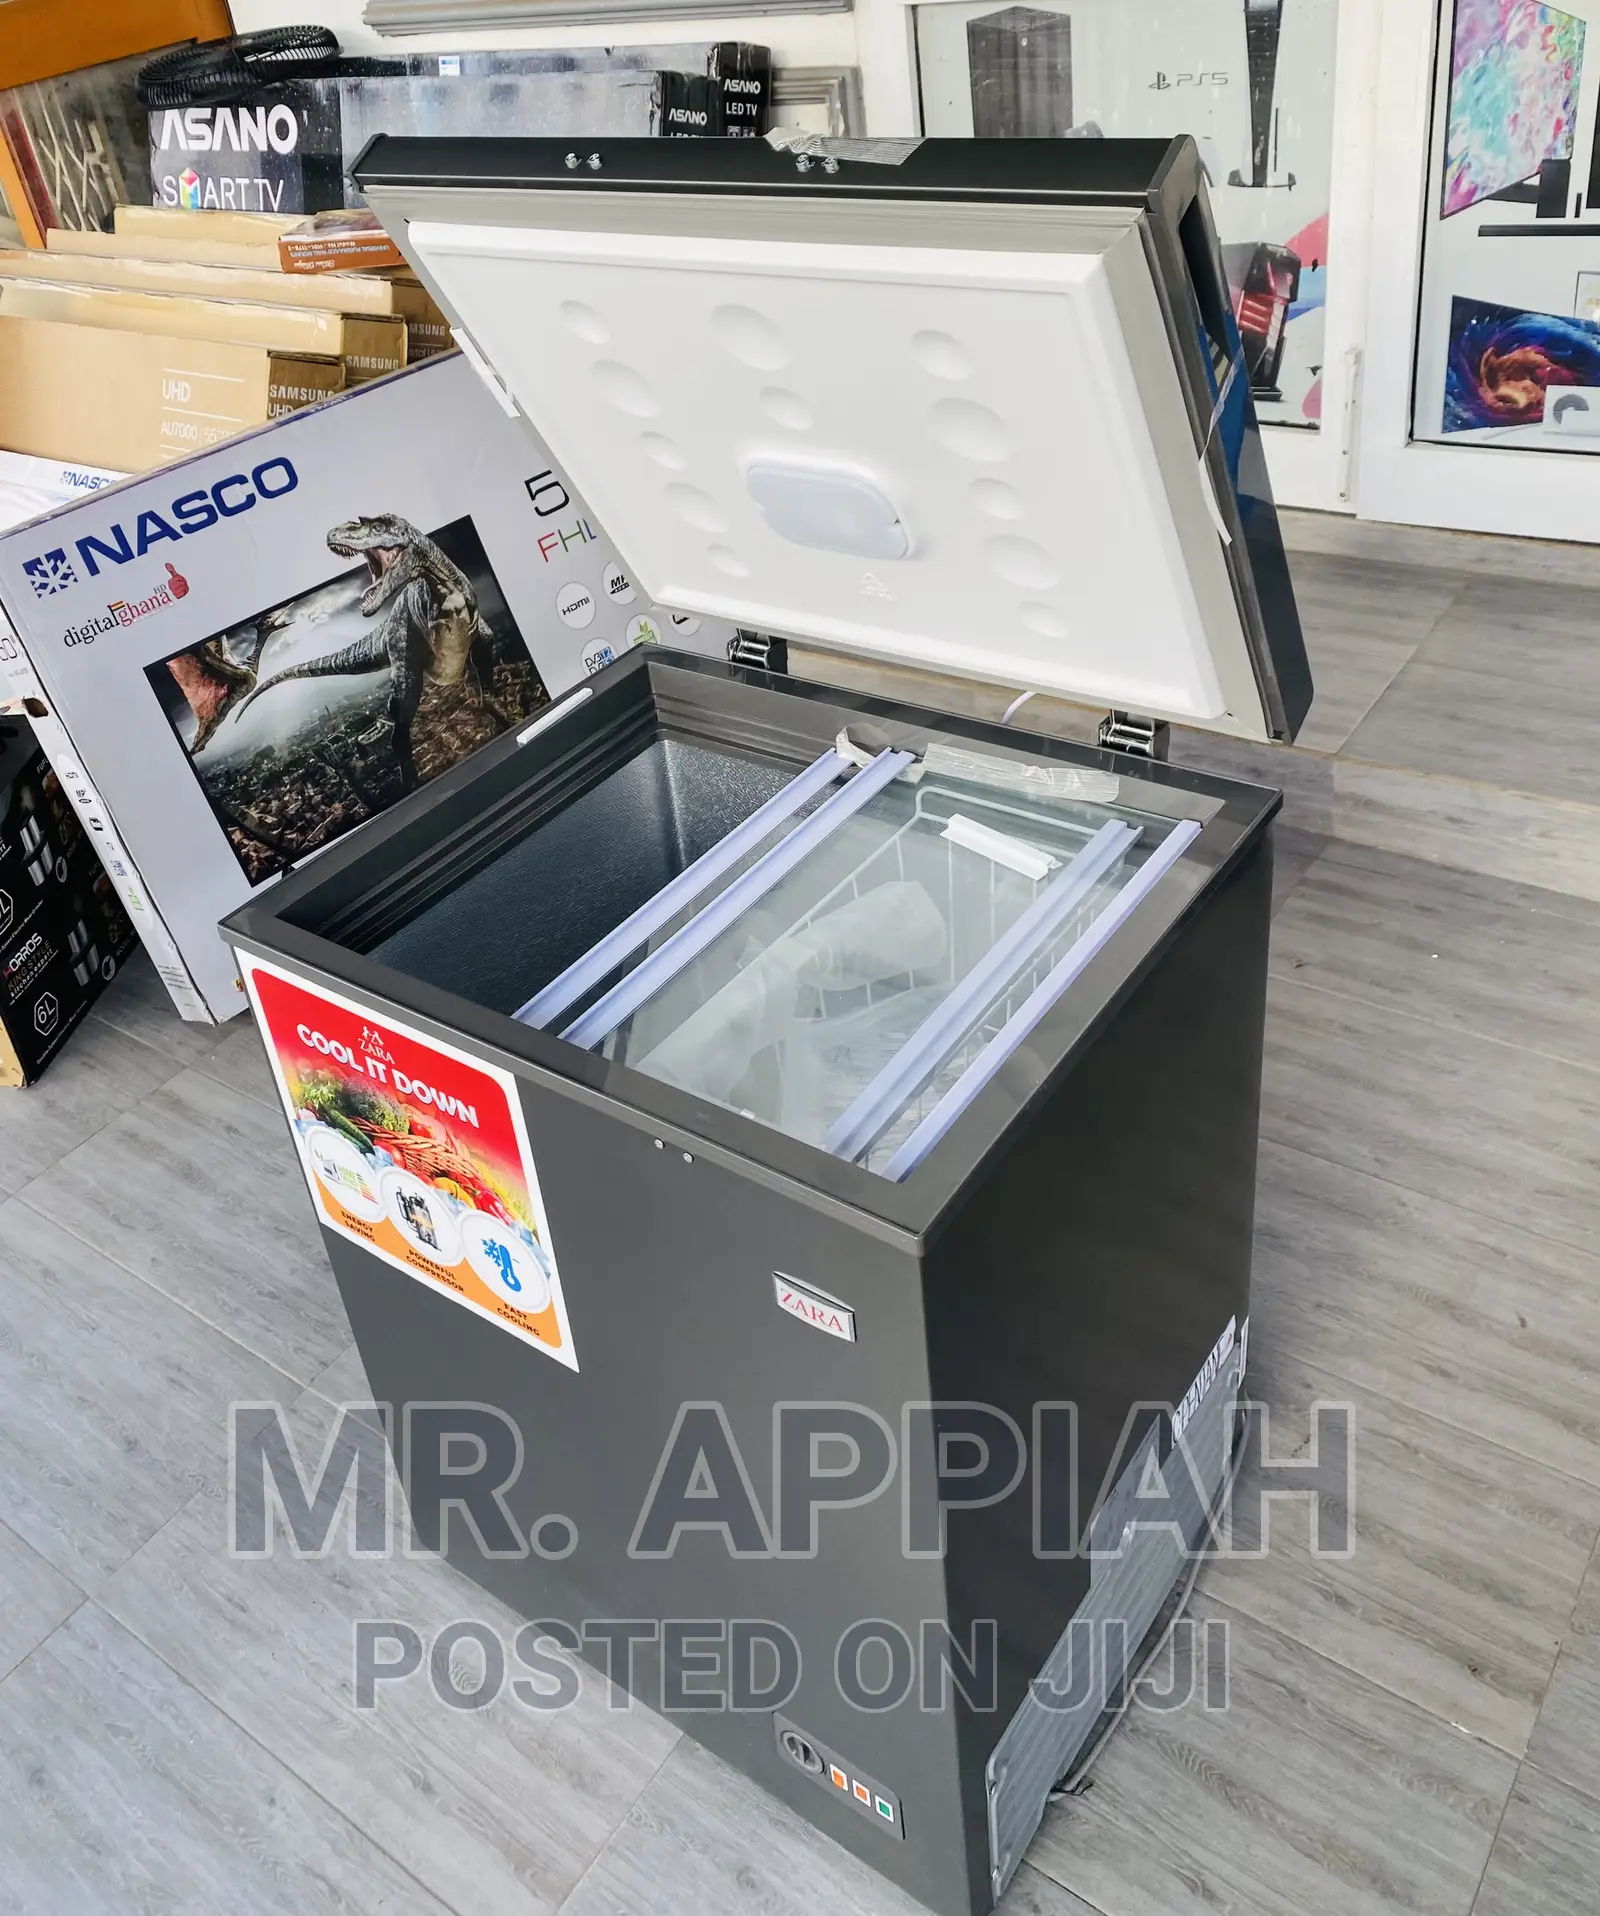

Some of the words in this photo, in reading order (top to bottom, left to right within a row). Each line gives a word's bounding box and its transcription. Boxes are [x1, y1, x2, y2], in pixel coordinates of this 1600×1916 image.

[724, 78, 761, 95] ASANO
[1176, 72, 1229, 87] PS5
[668, 107, 708, 127] ASANO
[726, 102, 744, 115] LED
[746, 103, 758, 116] TV
[160, 103, 299, 155] ASANO
[162, 167, 249, 211] SMART
[253, 178, 284, 212] TV
[409, 323, 446, 336] MSUNG
[346, 355, 399, 370] SAMSUNG
[162, 379, 191, 402] UHD
[160, 420, 198, 441] AU7000
[75, 456, 299, 577] NASCO
[562, 596, 591, 616] HDMI
[37, 1000, 56, 1024] 6L
[358, 1037, 396, 1065] ZARA
[296, 1023, 364, 1073] COOL
[365, 1055, 388, 1084] IT
[391, 1068, 480, 1129] DOWN
[340, 1210, 374, 1233] ENERGY
[344, 1220, 376, 1243] SAVING
[405, 1255, 465, 1293] COMPRESSOR
[408, 1249, 457, 1281] POWERFUL
[504, 1302, 528, 1321] FAST
[780, 1287, 844, 1333] ZARA
[496, 1307, 540, 1337] COOLING
